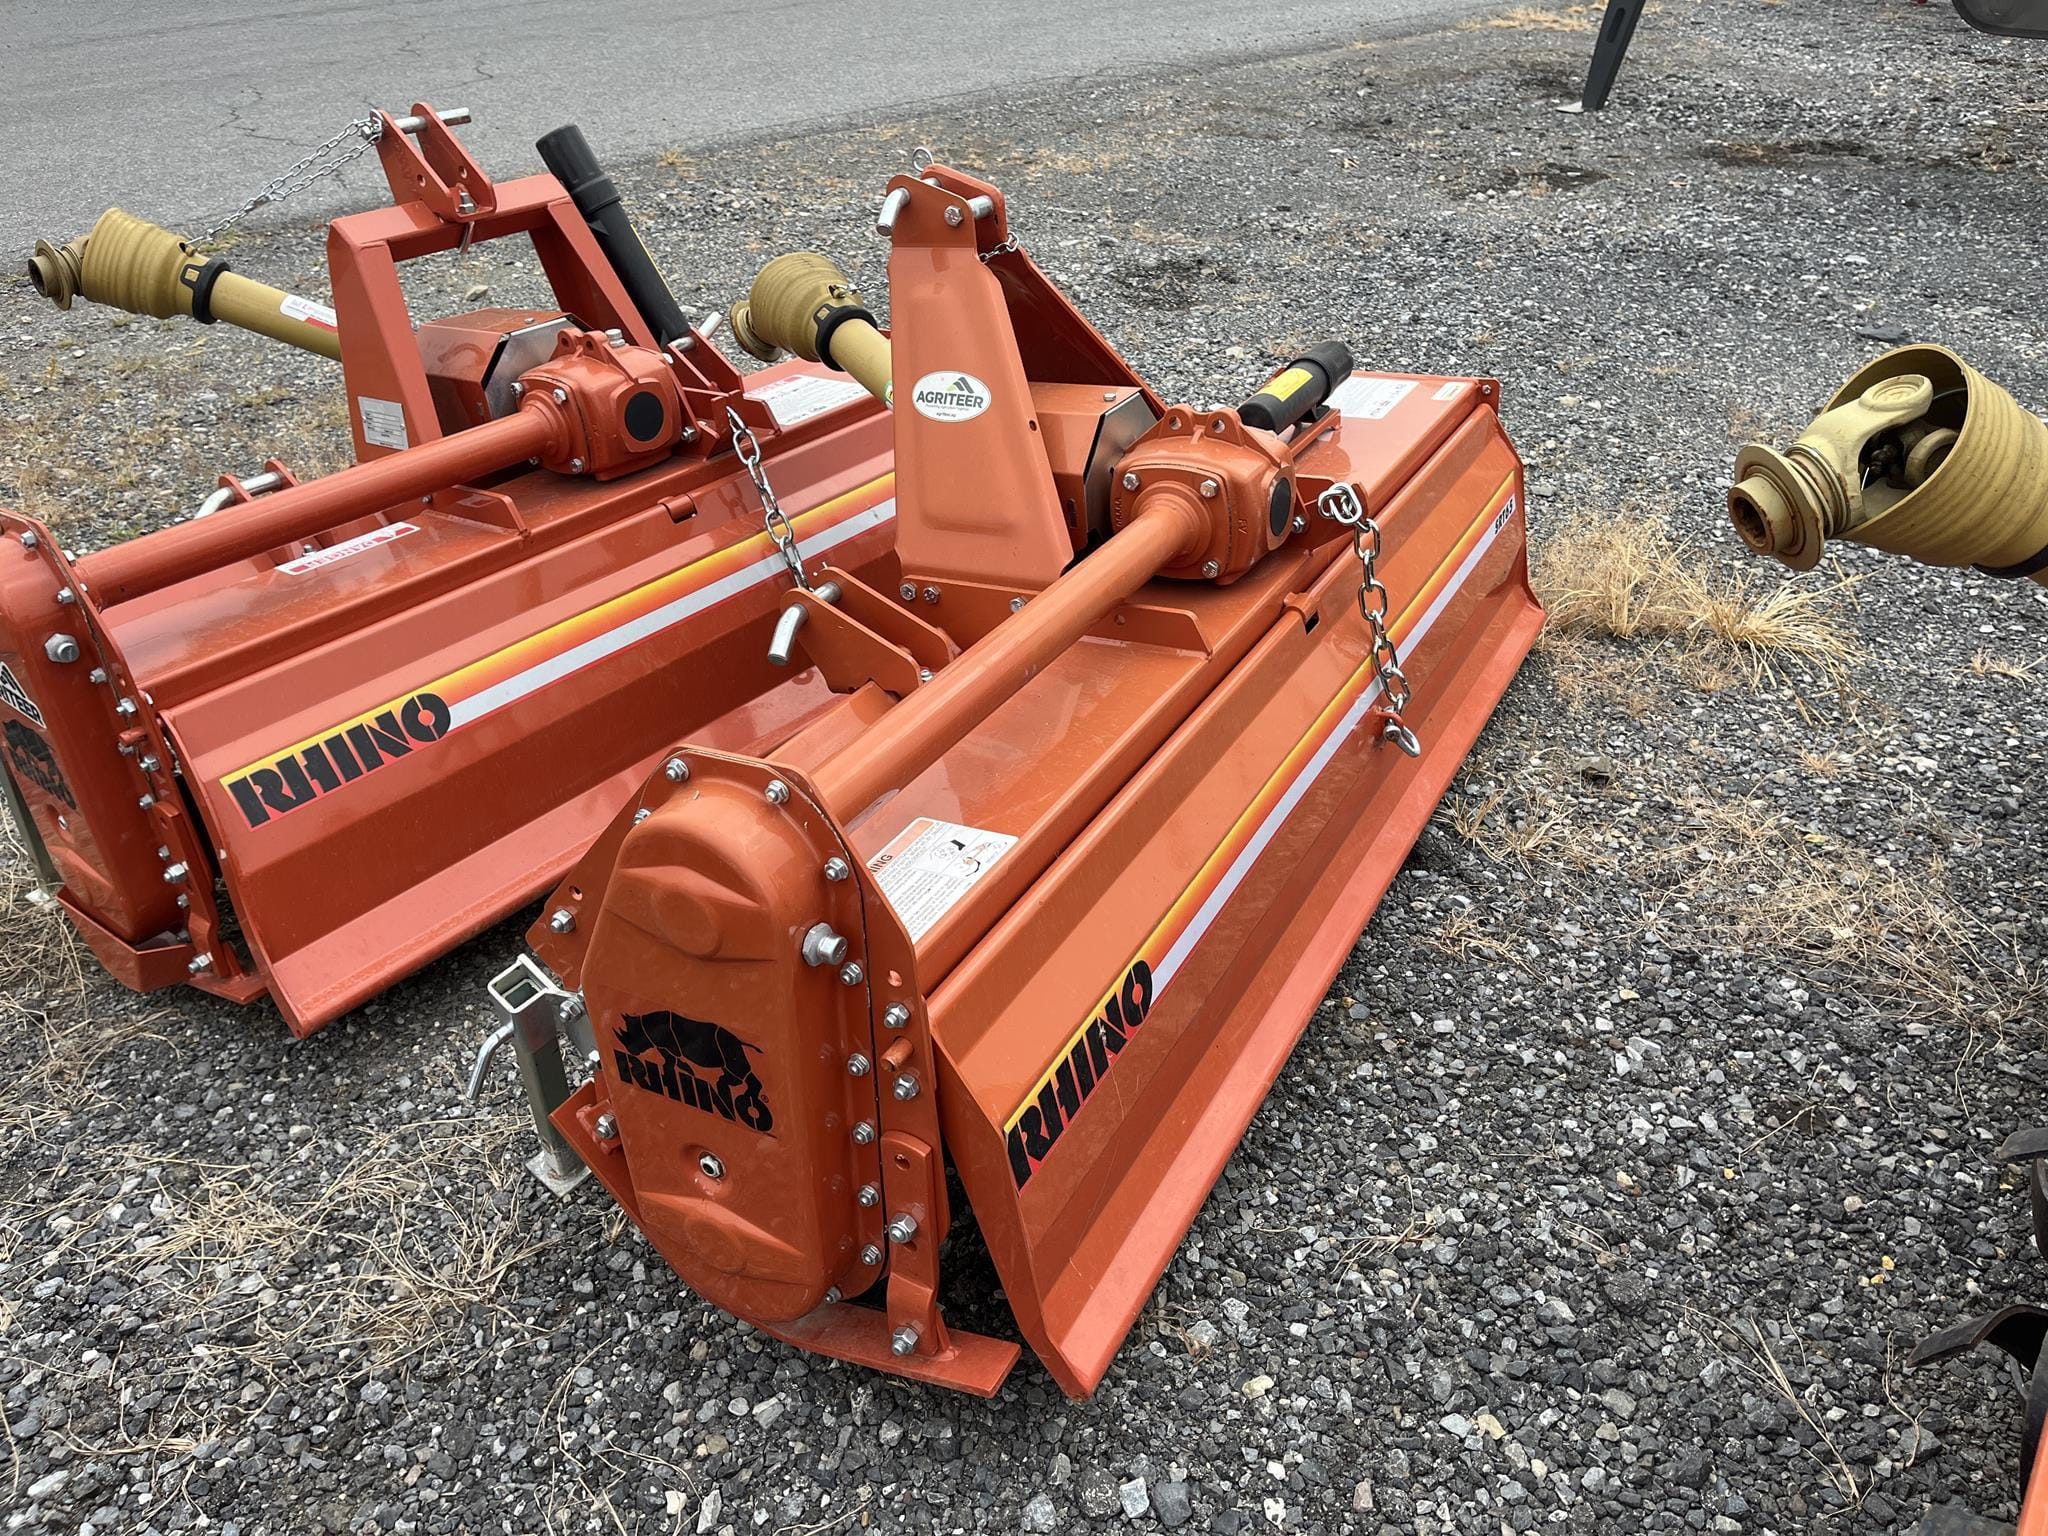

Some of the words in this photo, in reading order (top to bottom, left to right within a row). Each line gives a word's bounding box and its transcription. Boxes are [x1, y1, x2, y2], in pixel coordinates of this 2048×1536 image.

[916, 390, 984, 408] AGRITEER
[228, 692, 451, 828] RHINO
[613, 1048, 773, 1132] RHINO
[1007, 959, 1153, 1191] RHINO
